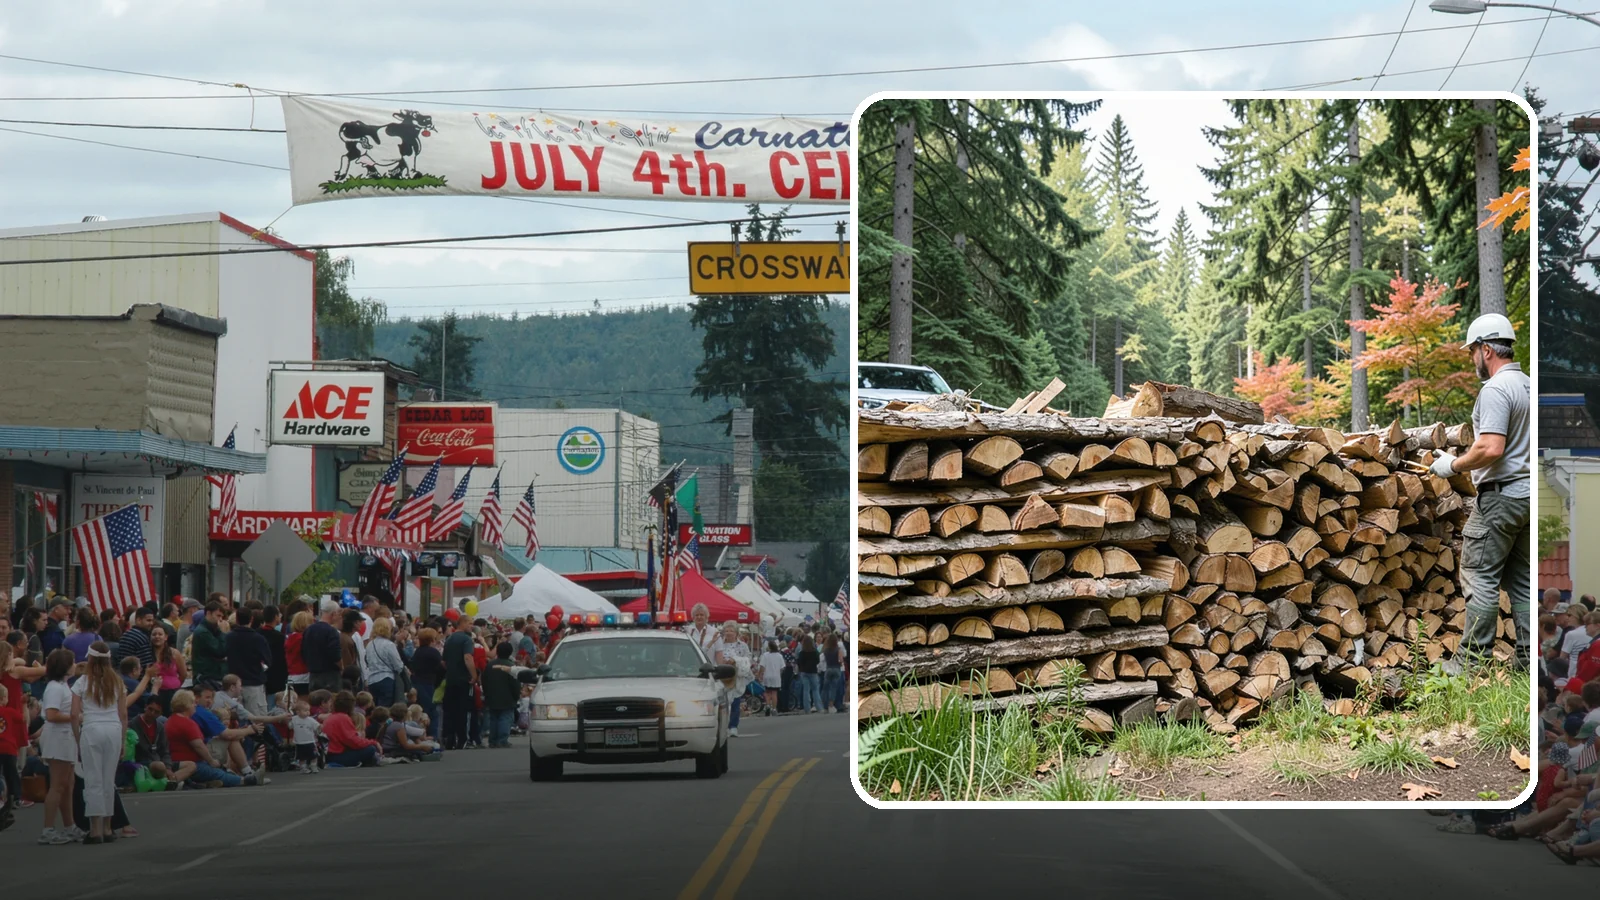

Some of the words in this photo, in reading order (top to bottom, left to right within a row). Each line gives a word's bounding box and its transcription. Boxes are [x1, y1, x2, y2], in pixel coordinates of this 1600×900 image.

[481, 141, 605, 192] JULY
[632, 149, 746, 198] 4th.
[697, 254, 850, 280] CROSSWA
[283, 380, 373, 420] ACE
[406, 410, 452, 422] CEDAR
[283, 421, 371, 436] Hardware
[416, 428, 477, 447] Coca-Cola
[95, 486, 124, 495] Vincent
[126, 486, 136, 495] de
[137, 486, 155, 495] Paul
[688, 526, 741, 535] CRNATION
[699, 535, 730, 543] GLASS
